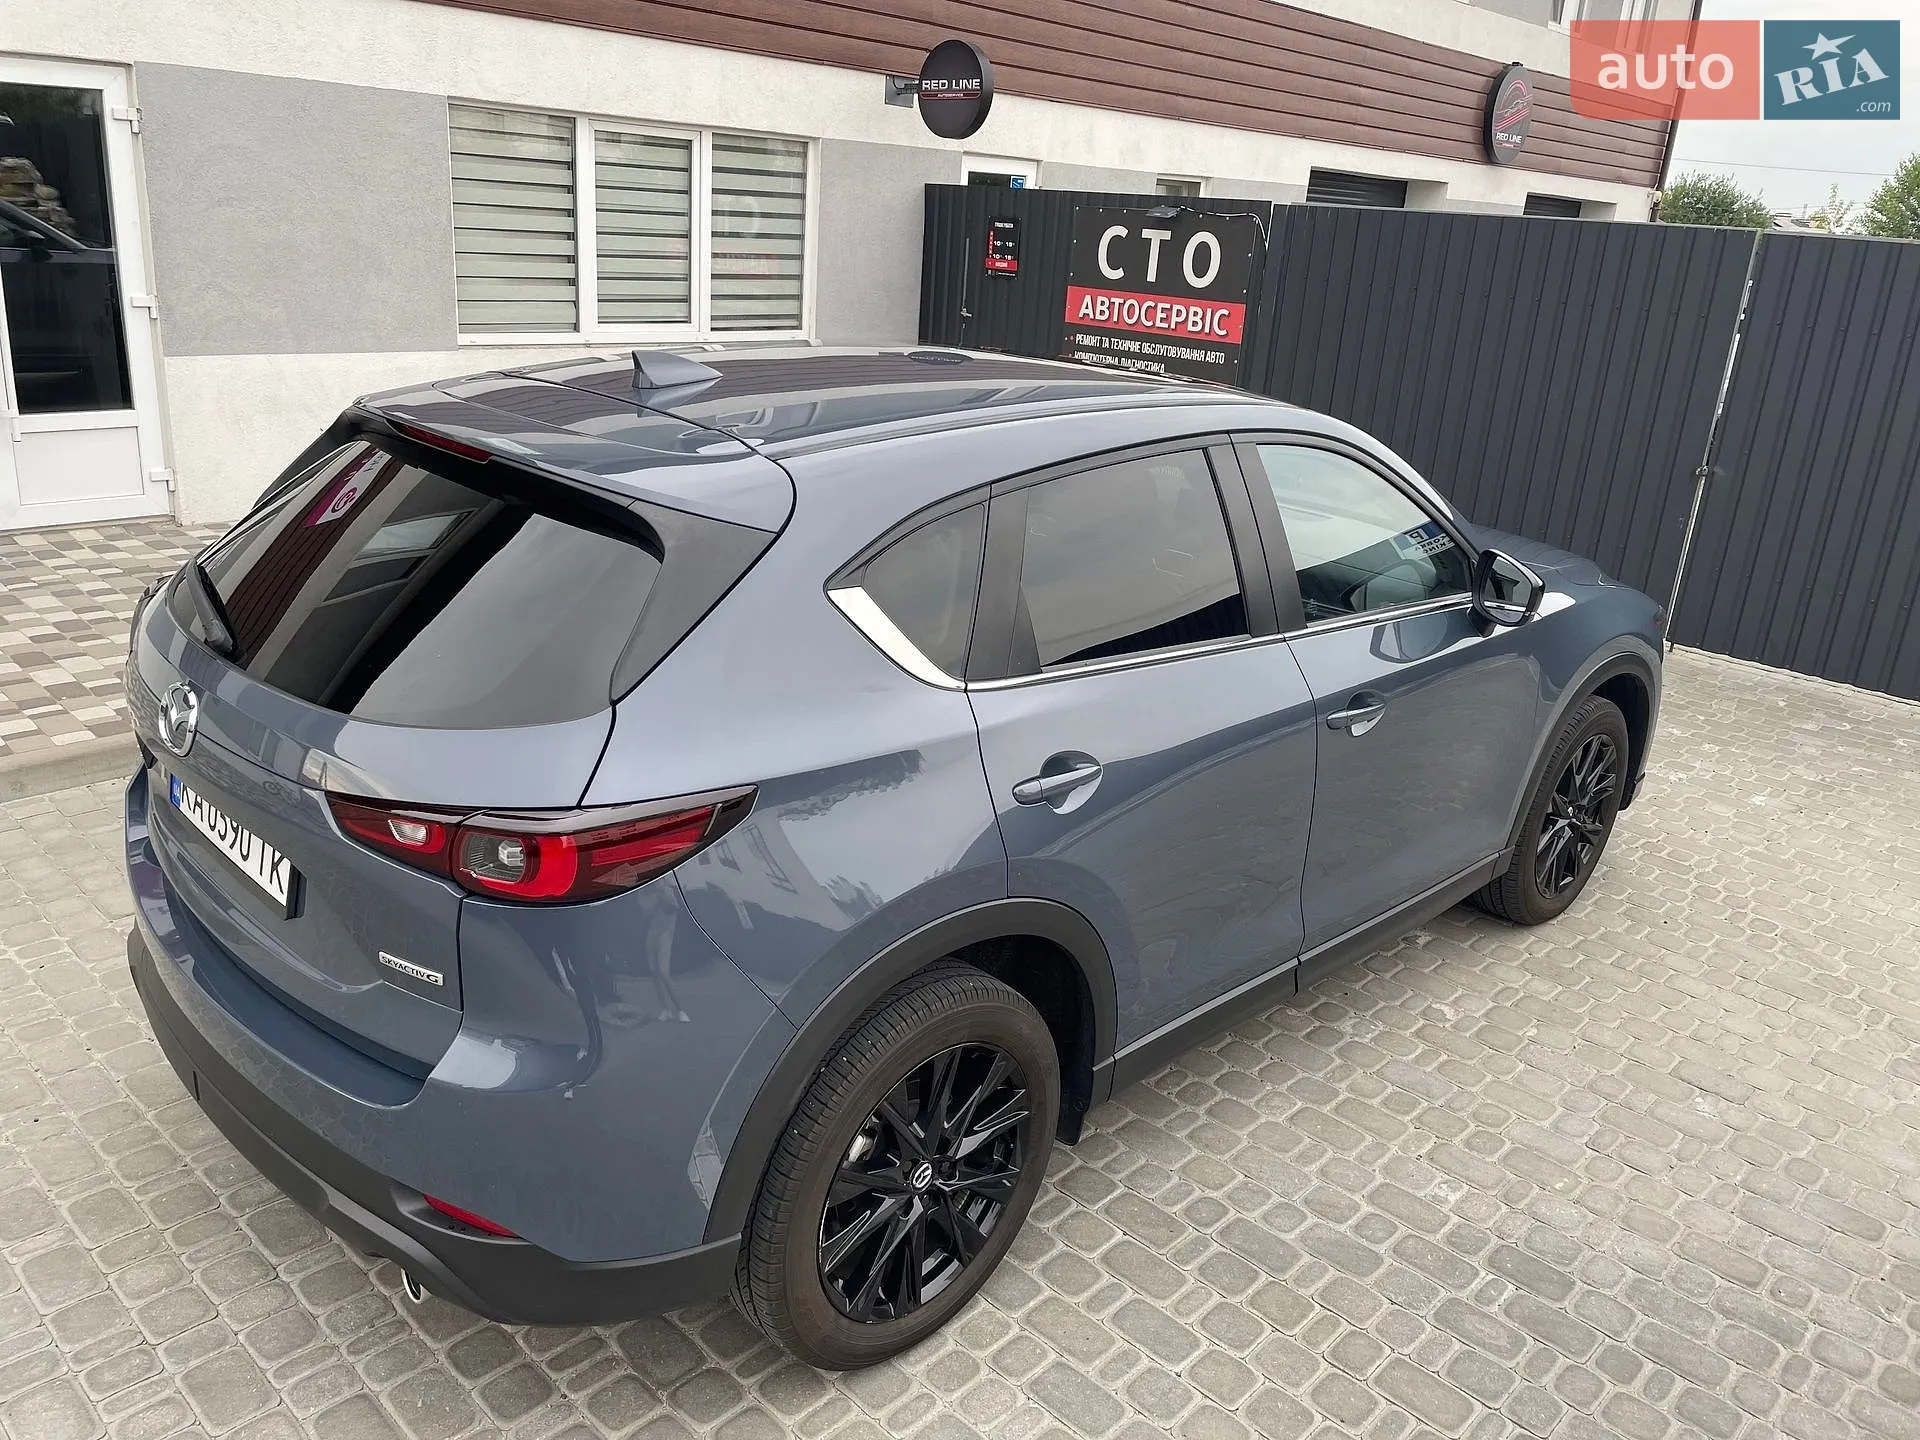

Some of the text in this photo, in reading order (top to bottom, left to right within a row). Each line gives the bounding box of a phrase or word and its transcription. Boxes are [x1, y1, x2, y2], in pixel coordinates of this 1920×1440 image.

[921, 79, 981, 90] RED LINE
[1097, 225, 1222, 289] СТО
[1078, 294, 1230, 336] АВТОСЕРВІС
[1075, 333, 1225, 364] РЕМОНТ ТА ТЕХНІЧНЕ ОБСЛУГОВУВАННЯ АВТО
[381, 956, 439, 984] SKYACTIV G
